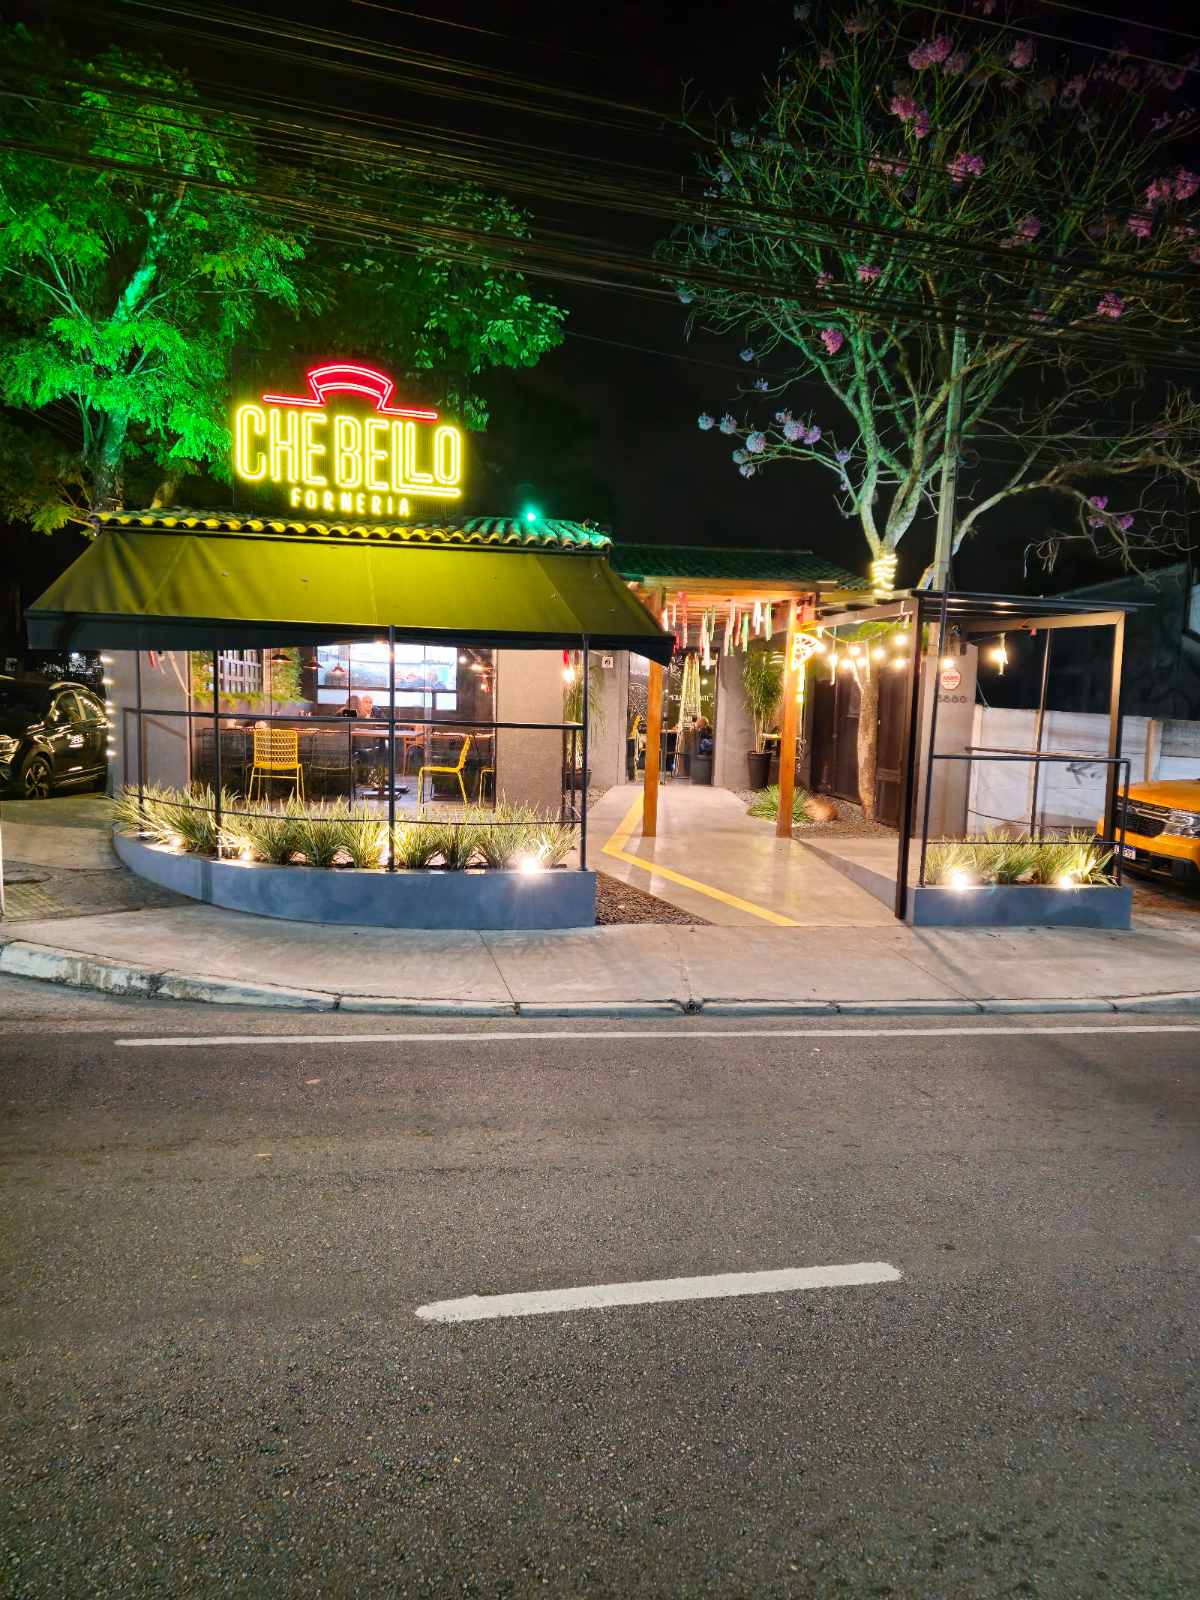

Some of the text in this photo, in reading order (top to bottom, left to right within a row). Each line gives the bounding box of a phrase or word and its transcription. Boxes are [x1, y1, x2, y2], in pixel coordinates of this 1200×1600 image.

[235, 404, 461, 498] CHE BELLO
[289, 487, 411, 517] FORNERIA
